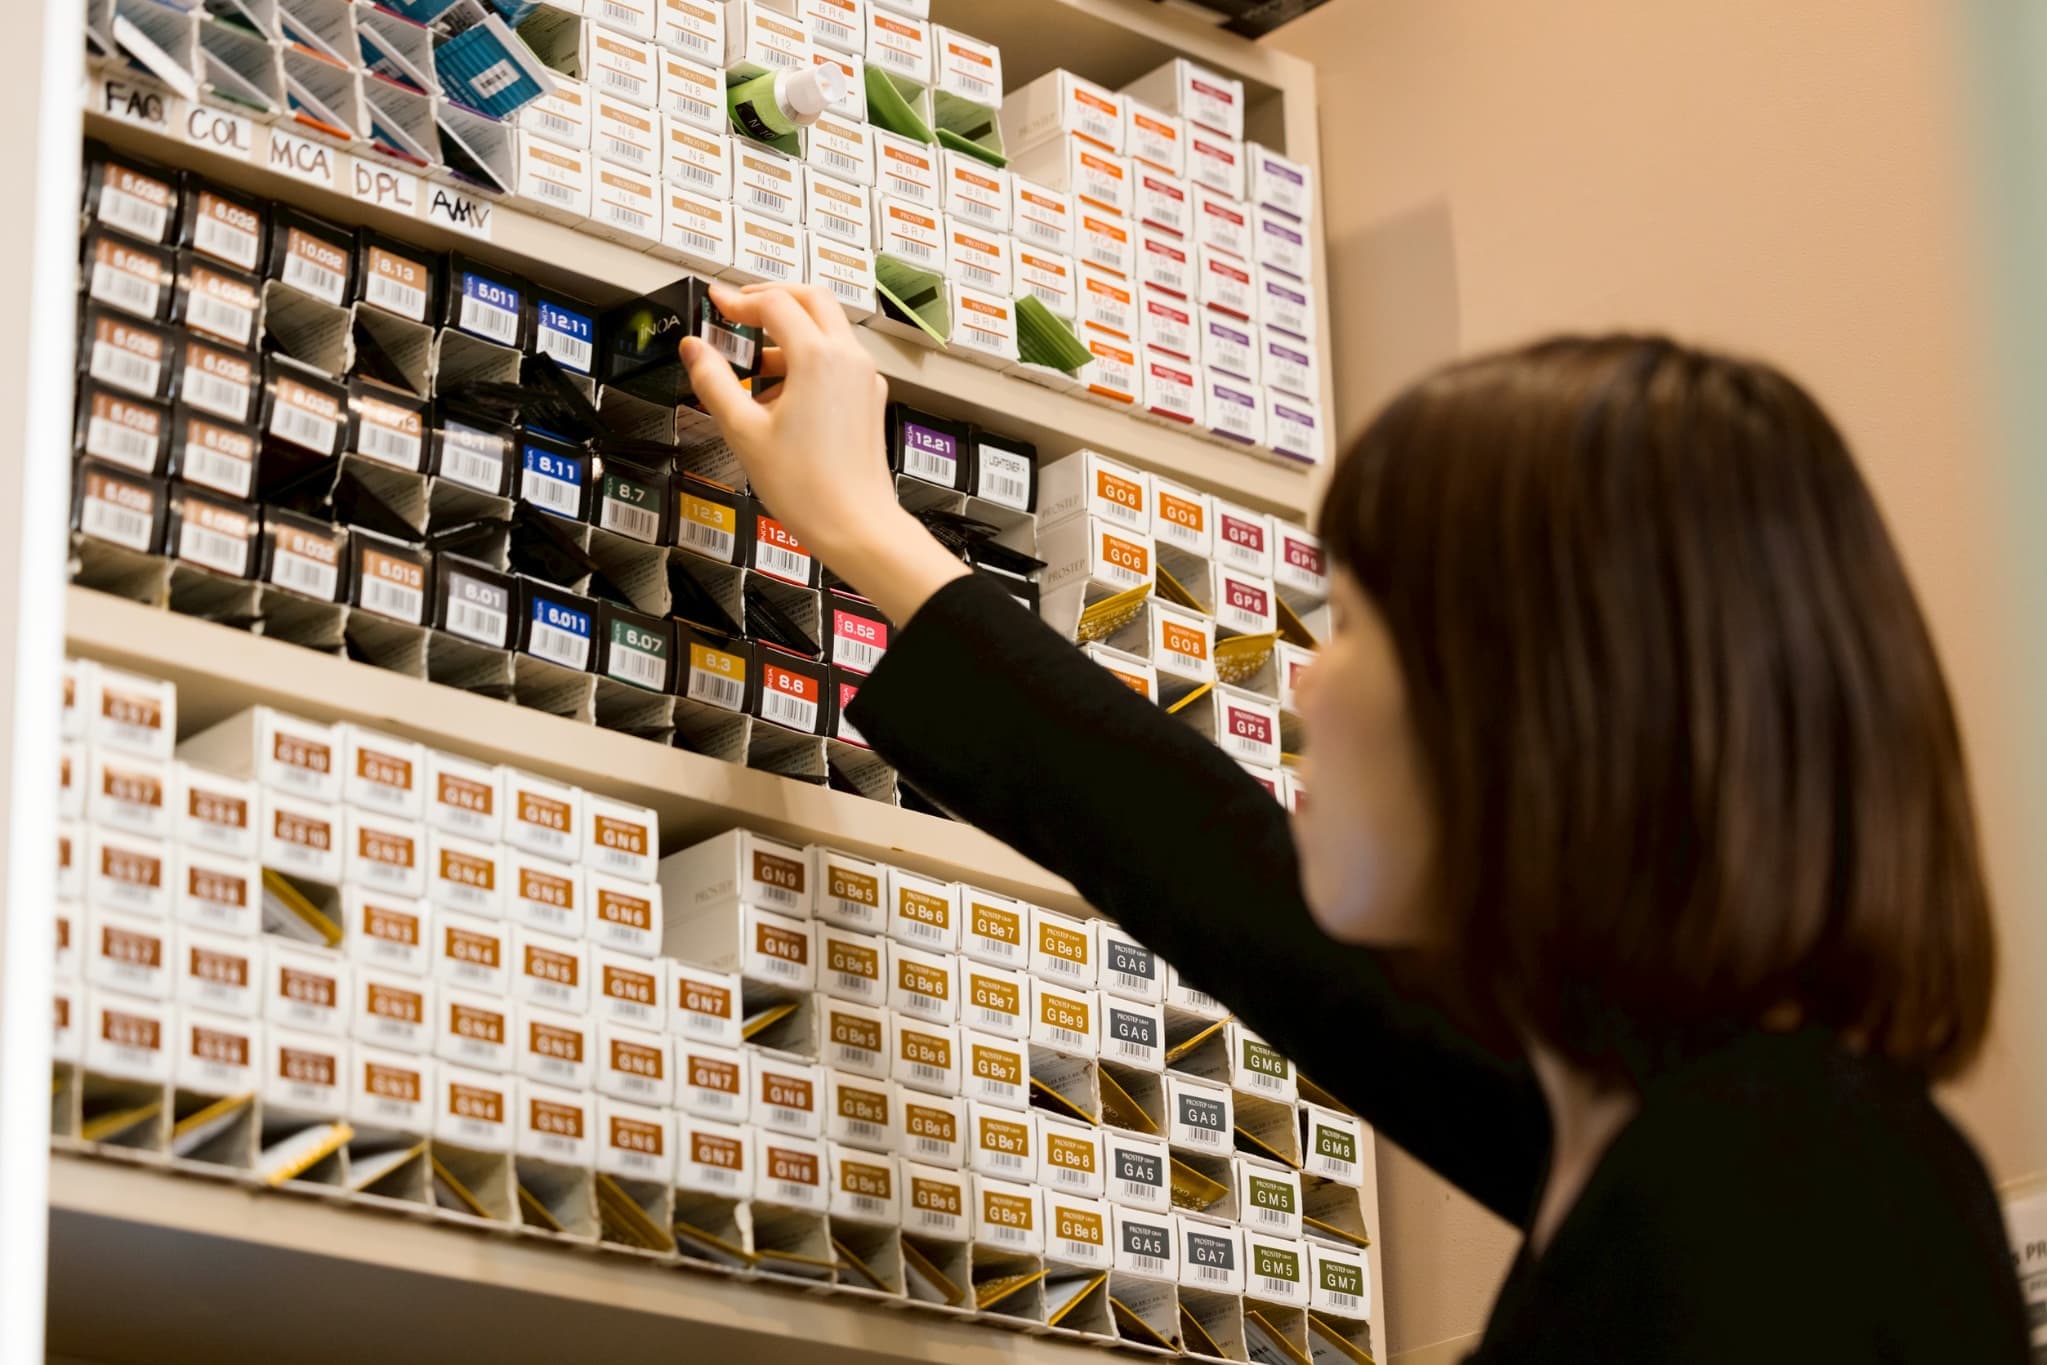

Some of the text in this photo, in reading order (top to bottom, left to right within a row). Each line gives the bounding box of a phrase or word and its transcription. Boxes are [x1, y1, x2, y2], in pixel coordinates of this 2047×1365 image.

[188, 108, 249, 151] COL
[269, 136, 331, 179] MCA
[355, 163, 412, 205] DPL
[379, 257, 415, 282] 8.13
[478, 283, 514, 308] 5.011
[550, 312, 587, 336] 12.11
[914, 431, 951, 454] 12.21
[539, 455, 575, 479] 8.11
[619, 483, 645, 502] 8.7
[692, 503, 723, 524] 12.3
[844, 620, 875, 640] 8.52
[705, 653, 732, 672] 8.3
[778, 674, 804, 694] 8.6
